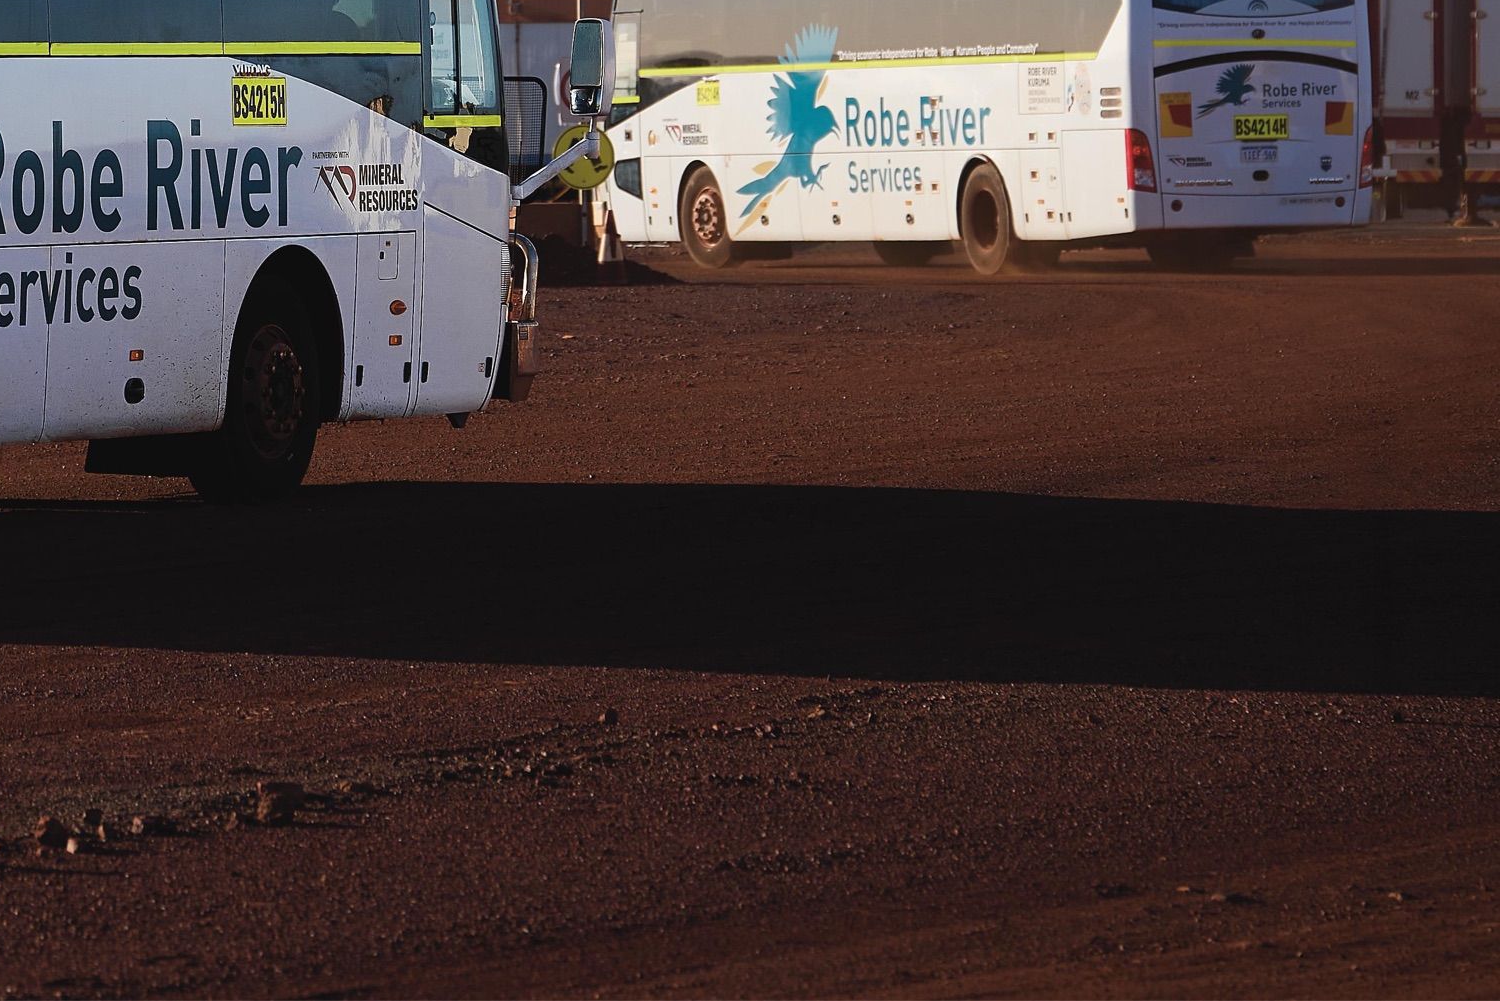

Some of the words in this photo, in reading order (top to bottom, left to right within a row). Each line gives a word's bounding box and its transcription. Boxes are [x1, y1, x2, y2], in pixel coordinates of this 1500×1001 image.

[232, 64, 272, 77] YUTONG
[1263, 84, 1298, 97] Robe
[1302, 82, 1338, 96] River
[233, 84, 286, 119] BS4215H
[1262, 99, 1302, 109] Services
[845, 96, 910, 147] Robe
[920, 95, 992, 146] River
[1236, 118, 1287, 136] BS4214H
[312, 151, 338, 160] PARTNERING
[338, 151, 350, 159] WITH
[146, 118, 304, 231] River
[358, 164, 404, 186] MINERAL
[848, 158, 922, 194] Services
[358, 189, 418, 212] RESOURCES
